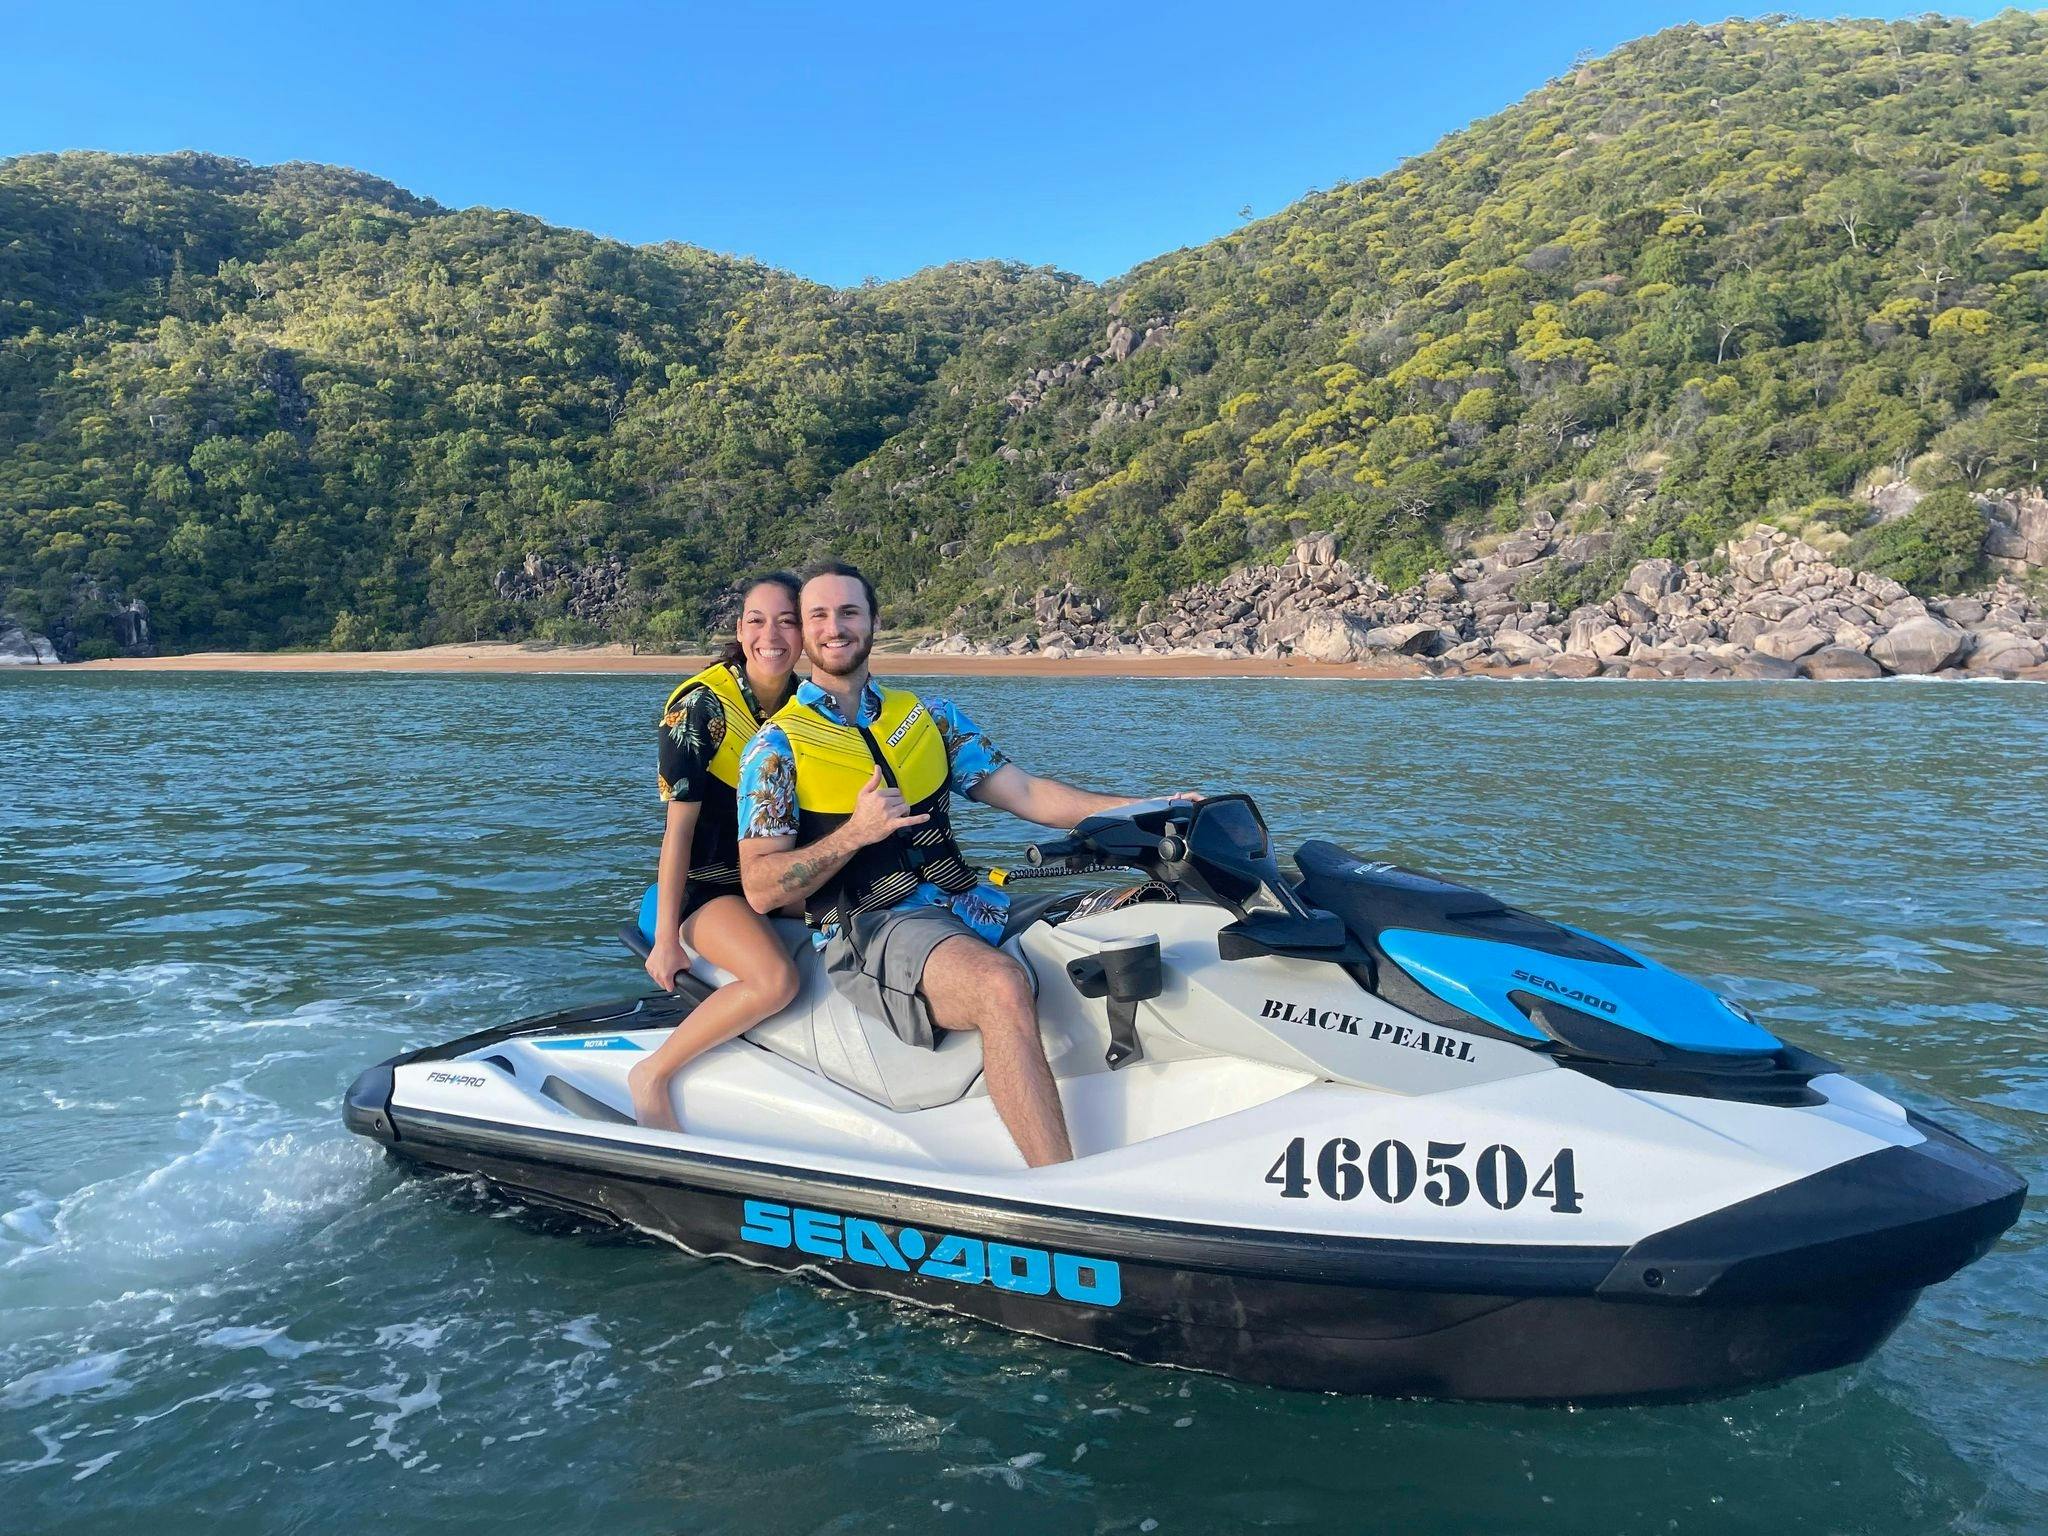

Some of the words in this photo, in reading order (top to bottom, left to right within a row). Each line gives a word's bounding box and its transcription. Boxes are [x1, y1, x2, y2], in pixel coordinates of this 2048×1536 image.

[886, 703, 925, 747] MOTION
[583, 1039, 608, 1048] ROTAX
[1260, 999, 1363, 1036] BLACK
[1369, 1021, 1476, 1062] PEARL
[1264, 1137, 1584, 1214] 460504
